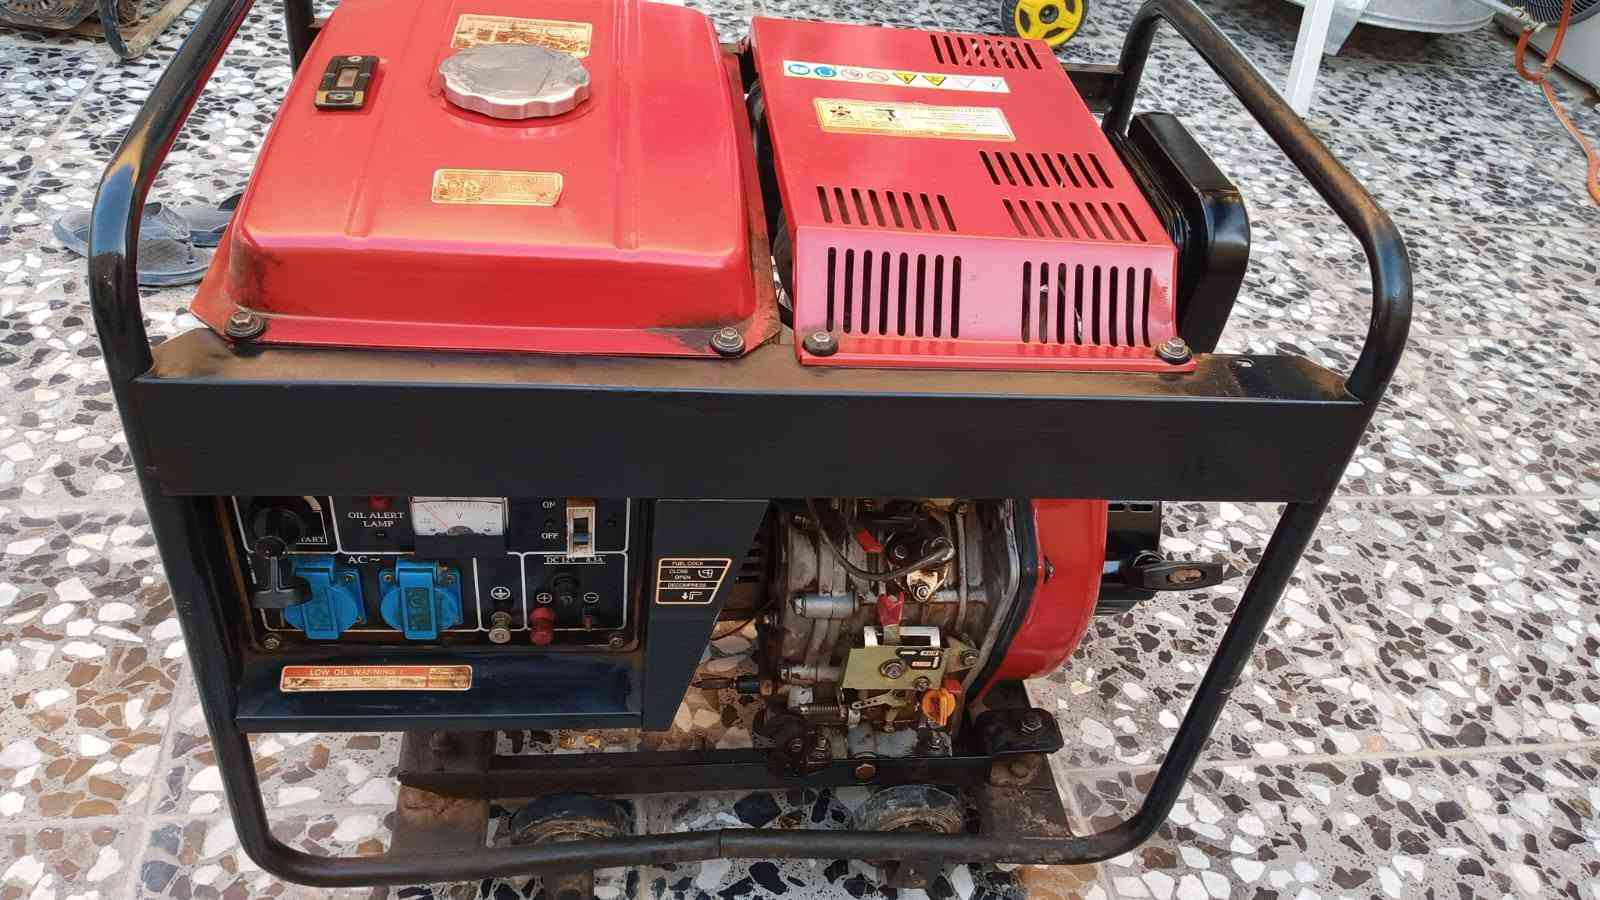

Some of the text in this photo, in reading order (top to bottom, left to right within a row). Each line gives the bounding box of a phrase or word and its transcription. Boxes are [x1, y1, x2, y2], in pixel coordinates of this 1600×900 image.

[542, 501, 555, 509] ON
[347, 511, 405, 519] OIL ALERT
[362, 520, 395, 528] LAMP
[541, 532, 560, 540] OFF
[347, 555, 368, 564] AC
[546, 556, 561, 564] DC
[309, 667, 331, 677] LOW
[333, 667, 348, 677] OIL
